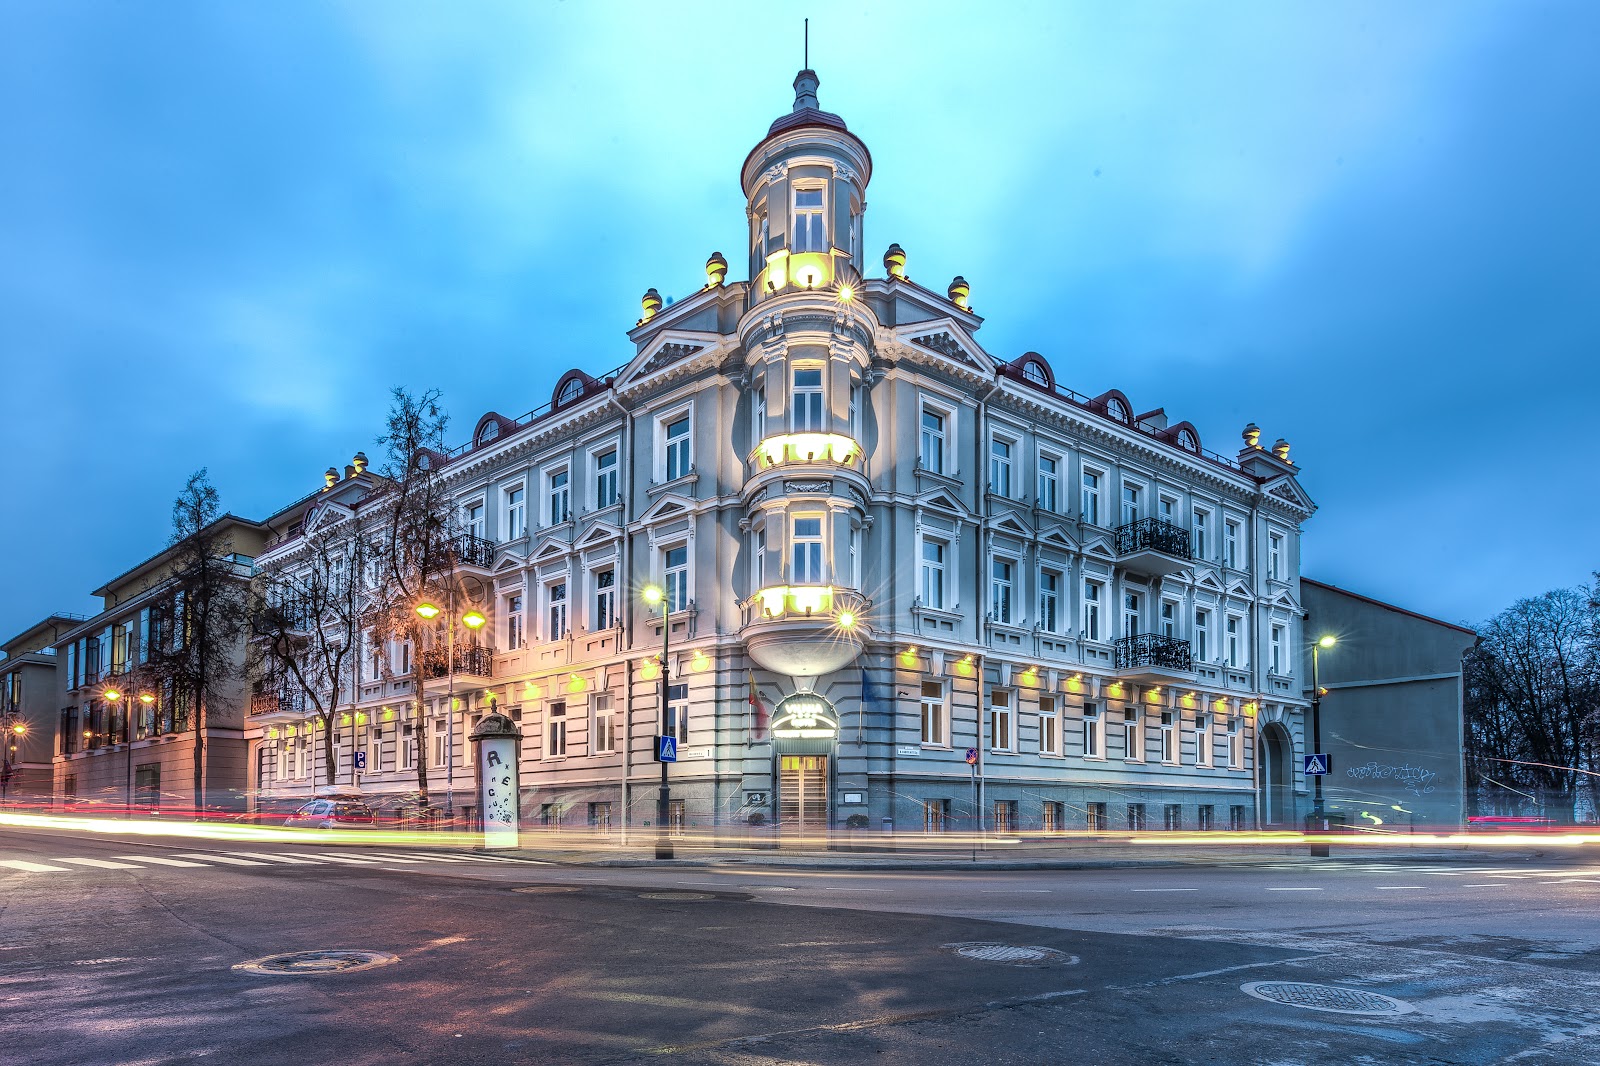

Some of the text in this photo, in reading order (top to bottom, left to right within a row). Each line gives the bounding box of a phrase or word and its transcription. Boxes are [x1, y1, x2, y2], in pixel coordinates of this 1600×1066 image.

[357, 752, 364, 761] P
[486, 750, 502, 768] R
[502, 776, 510, 786] E
[488, 788, 495, 796] G
